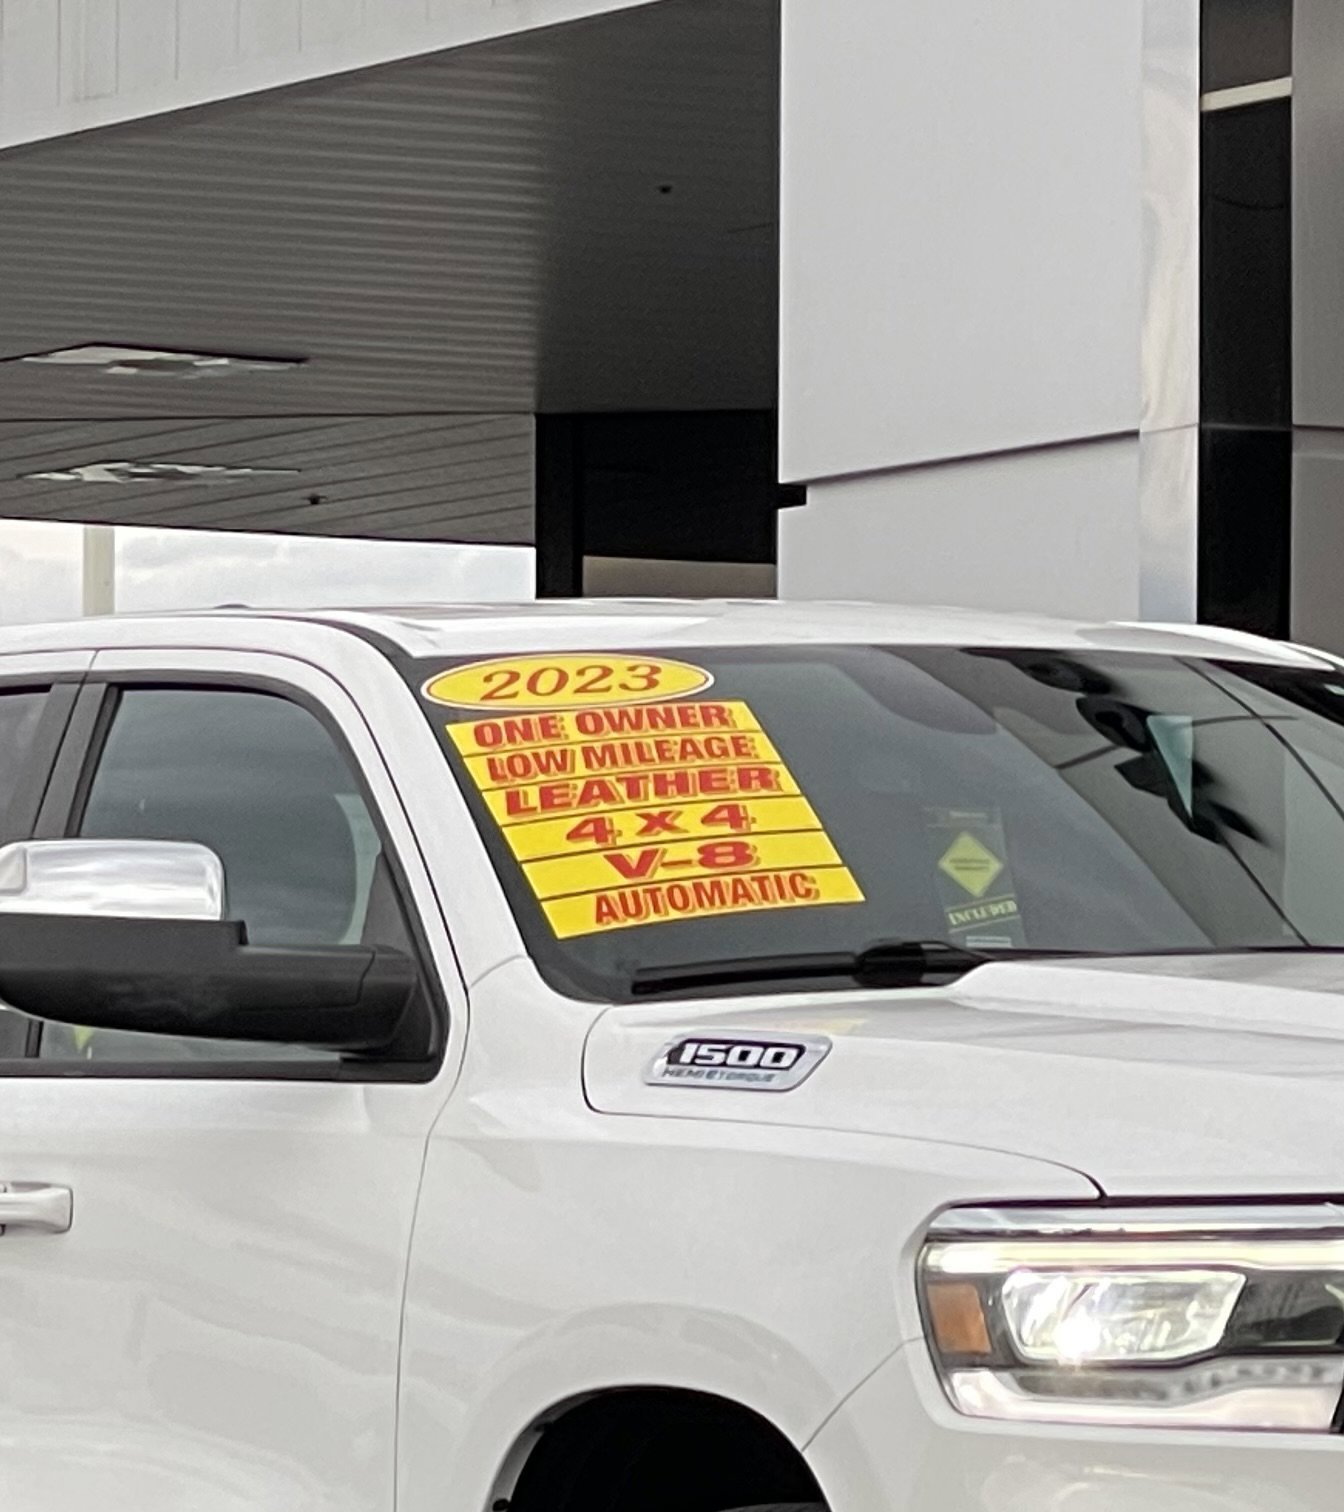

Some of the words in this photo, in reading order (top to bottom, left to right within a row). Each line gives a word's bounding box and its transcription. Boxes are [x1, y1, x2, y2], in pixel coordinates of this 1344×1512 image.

[480, 663, 664, 702] 2023
[473, 717, 567, 748] ONE
[576, 704, 733, 736] OWNER
[488, 750, 575, 783] LOW
[581, 735, 759, 771] MILEAGE
[507, 767, 780, 816] LEATHER
[604, 839, 761, 880] V-8
[595, 873, 820, 924] AUTOMATIC
[679, 1042, 798, 1068] 1500
